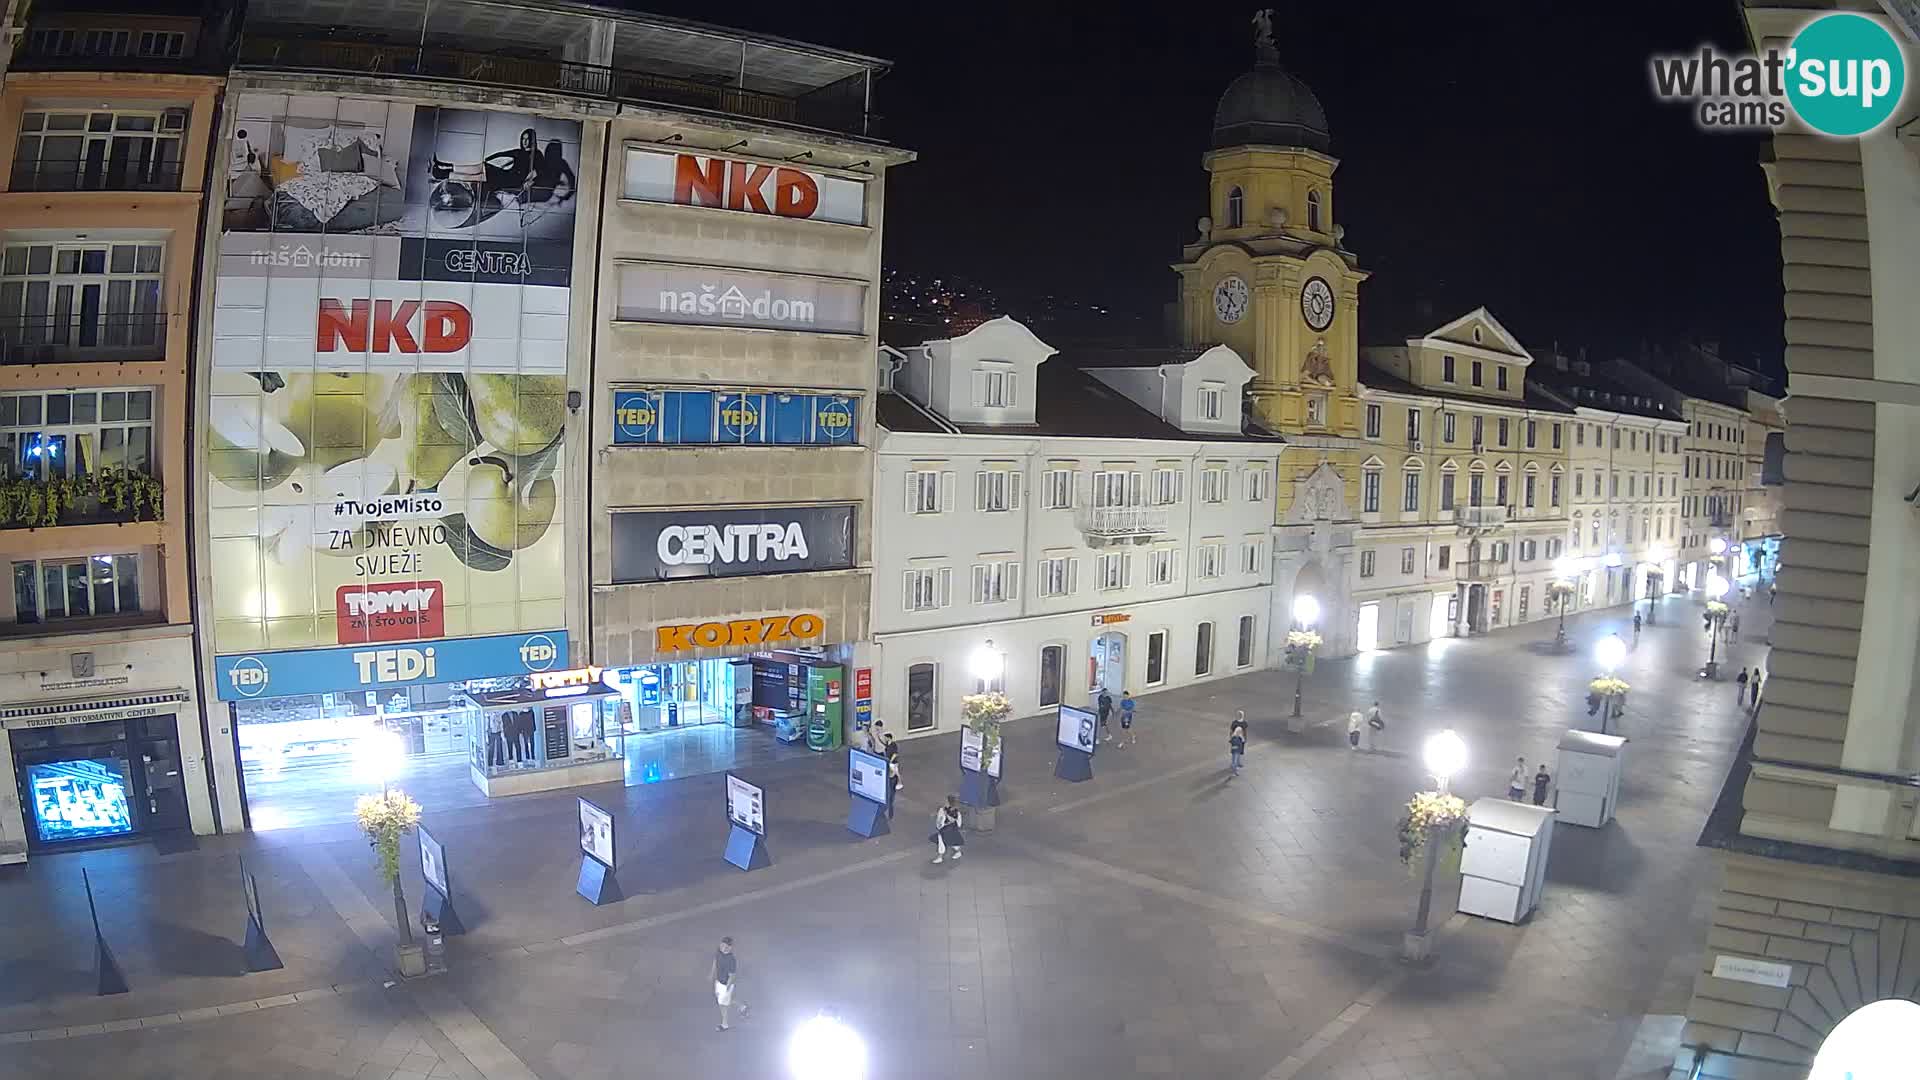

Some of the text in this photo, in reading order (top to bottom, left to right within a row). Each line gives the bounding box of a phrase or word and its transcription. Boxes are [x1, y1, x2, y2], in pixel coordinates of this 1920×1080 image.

[674, 154, 819, 219] NKD
[250, 245, 361, 268] naš dom
[445, 250, 531, 275] CENTRA
[659, 283, 815, 323] naš dom
[317, 298, 473, 353] NKD
[616, 408, 656, 426] TEDi
[721, 409, 758, 426] TEDi
[818, 412, 851, 427] TEDi
[334, 499, 442, 516] #TvojeMisto
[329, 524, 447, 551] ZA DNEVNO
[657, 521, 809, 566] CENTRA
[355, 550, 422, 576] SVJEŽE
[344, 588, 435, 616] TOMMY
[656, 614, 825, 652] KORZO
[354, 647, 436, 684] TEDi
[520, 645, 557, 663] TEDi
[229, 666, 268, 686] TEDi
[530, 666, 603, 690] TOMMY
